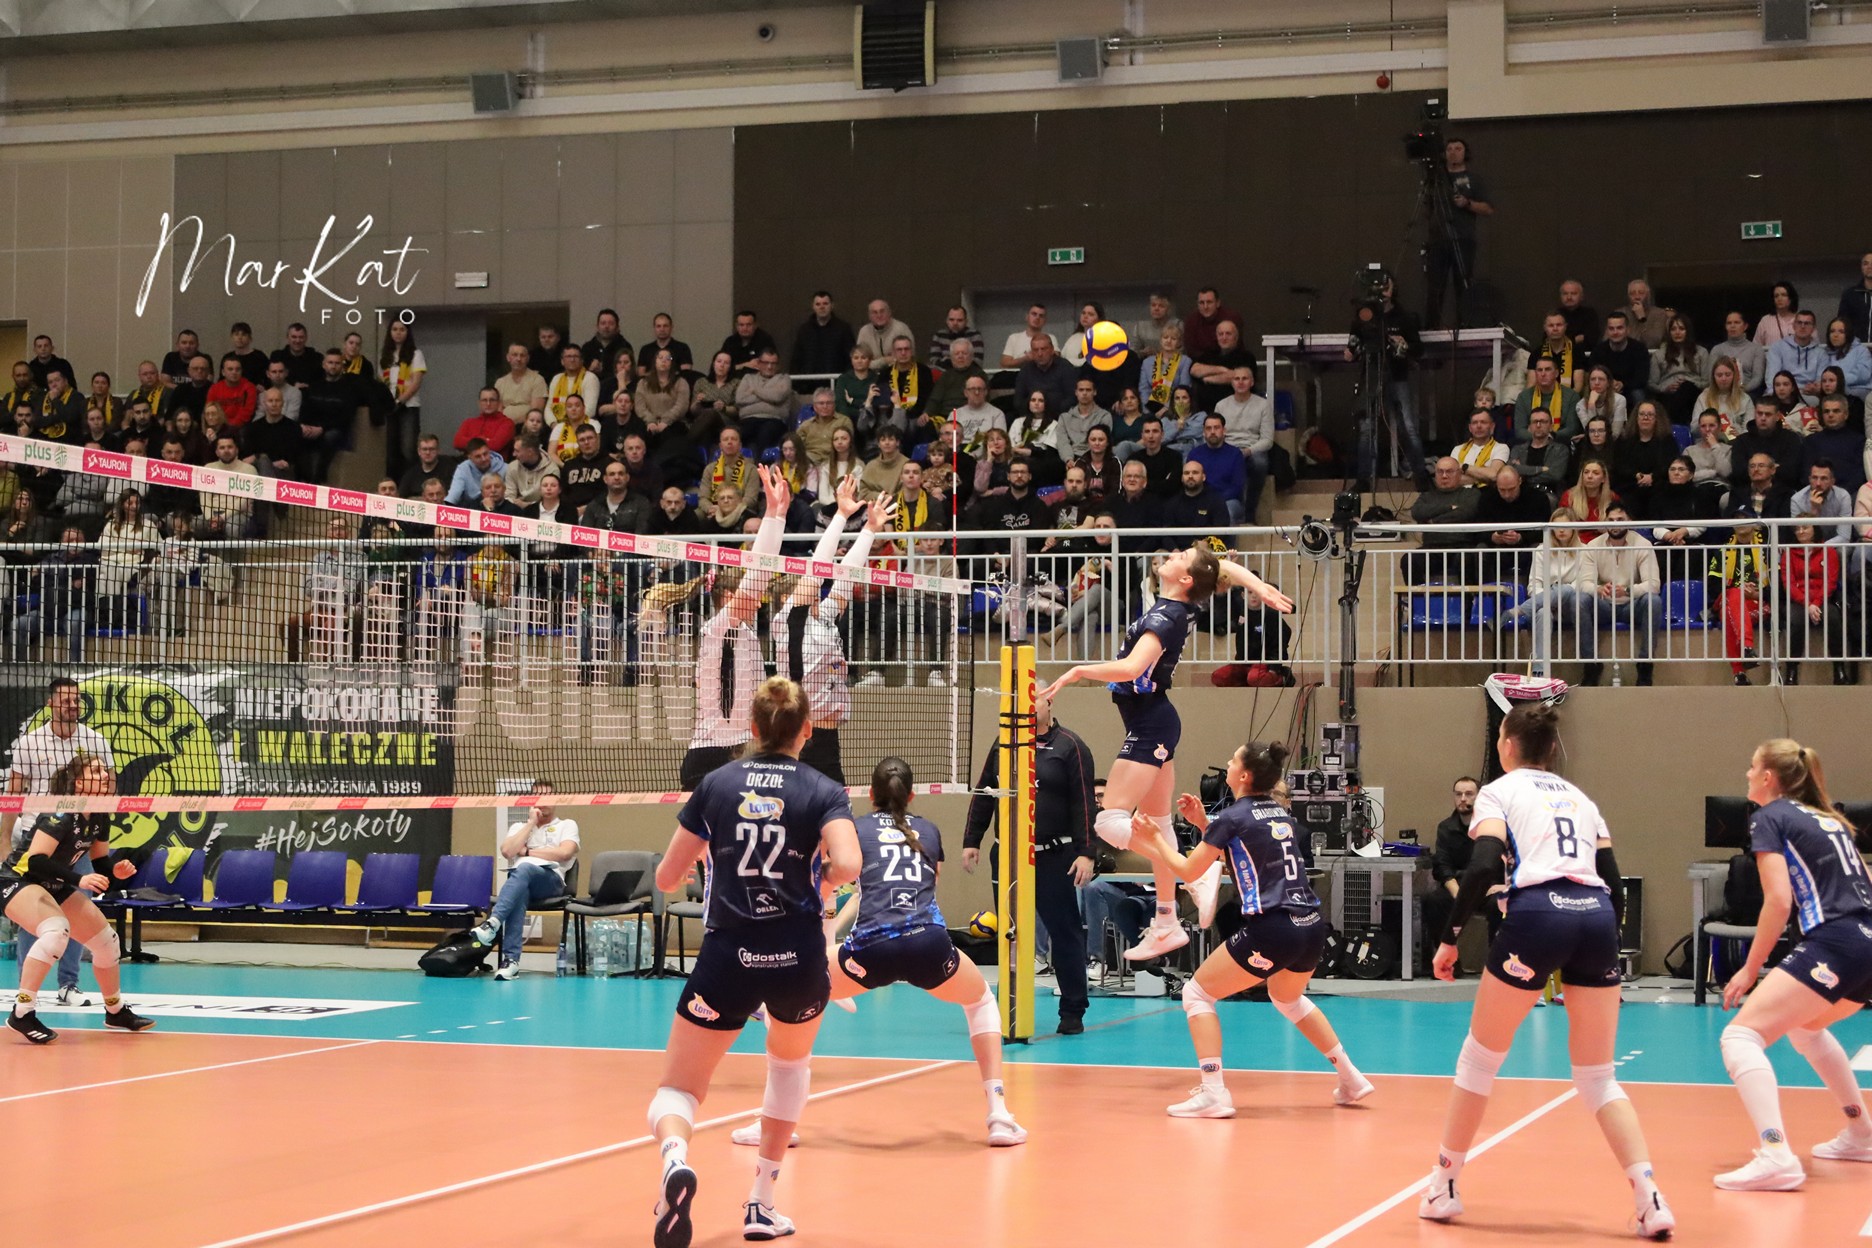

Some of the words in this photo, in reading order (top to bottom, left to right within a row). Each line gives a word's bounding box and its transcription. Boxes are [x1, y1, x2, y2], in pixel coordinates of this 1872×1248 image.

[24, 442, 52, 461] plus
[98, 457, 128, 471] TAURON
[160, 467, 188, 481] TAURON
[200, 474, 216, 485] LIGA
[228, 475, 251, 492] plus
[289, 487, 313, 500] TAURON
[340, 495, 364, 508] TAURON
[373, 501, 386, 511] LIGA
[396, 502, 415, 518] plus
[447, 512, 468, 524] TAURON
[490, 518, 510, 530] TAURON
[517, 523, 528, 532] LIGA
[537, 523, 553, 537] plus
[579, 532, 598, 542] TAURON
[616, 538, 634, 547] TAURON
[234, 687, 439, 721] NIEPOKONANE
[257, 730, 437, 766] WALECZNE
[746, 772, 785, 789] ORZOŁ
[754, 762, 797, 772] DECATHLON
[245, 778, 280, 793] ROK
[286, 776, 379, 795] ZAŁOŻENIA
[382, 780, 422, 795] 1989
[1533, 780, 1570, 792] NOWAK
[56, 799, 76, 811] plus
[127, 800, 150, 809] TAURON
[749, 802, 776, 814] LOTTO
[735, 821, 787, 880] 22
[1554, 816, 1578, 859] 8
[1827, 833, 1862, 876] 14
[880, 844, 922, 882] 23
[1281, 841, 1298, 881] 5
[694, 1003, 713, 1016] LOTTO
